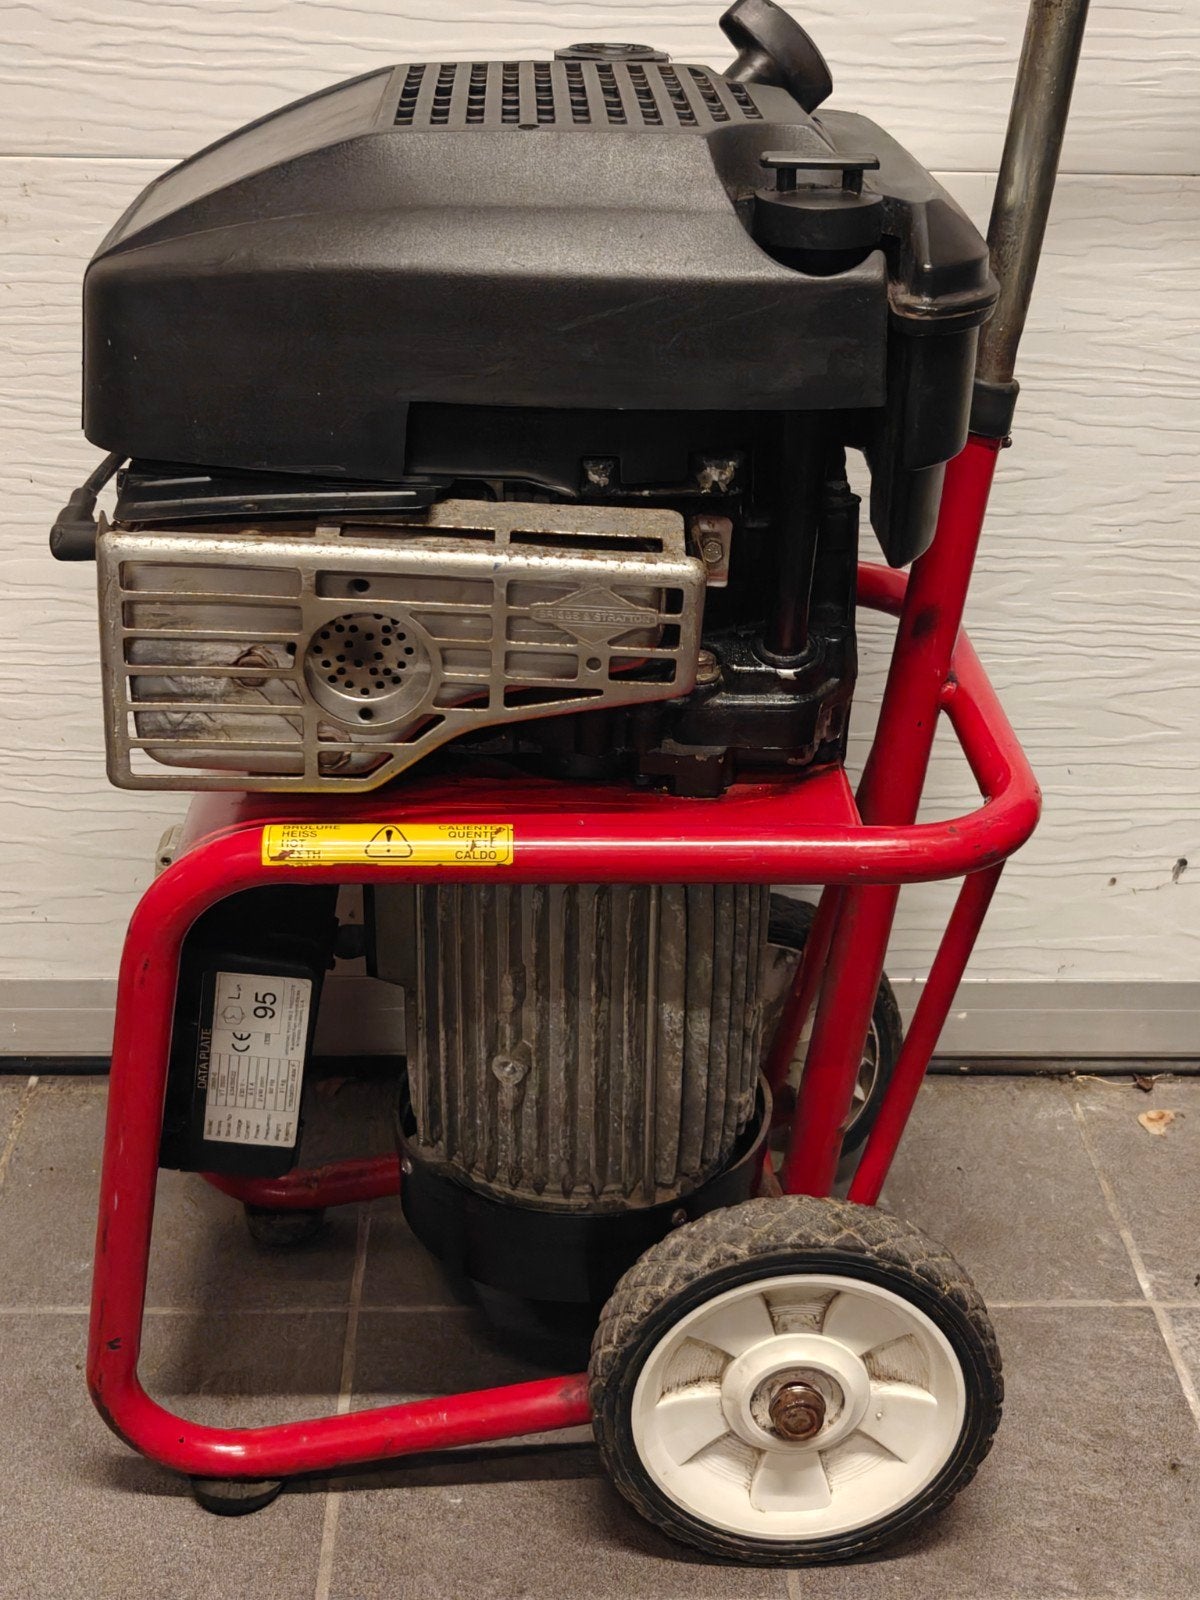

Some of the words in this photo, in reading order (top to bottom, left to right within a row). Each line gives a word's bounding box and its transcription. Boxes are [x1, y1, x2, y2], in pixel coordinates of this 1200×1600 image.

[592, 612, 652, 624] STRATTON
[281, 830, 318, 838] HEISS
[448, 831, 497, 839] QUENTE
[455, 850, 497, 860] CALDO
[253, 991, 277, 1020] 95
[199, 1028, 211, 1060] PLATE
[197, 1063, 210, 1090] DATA
